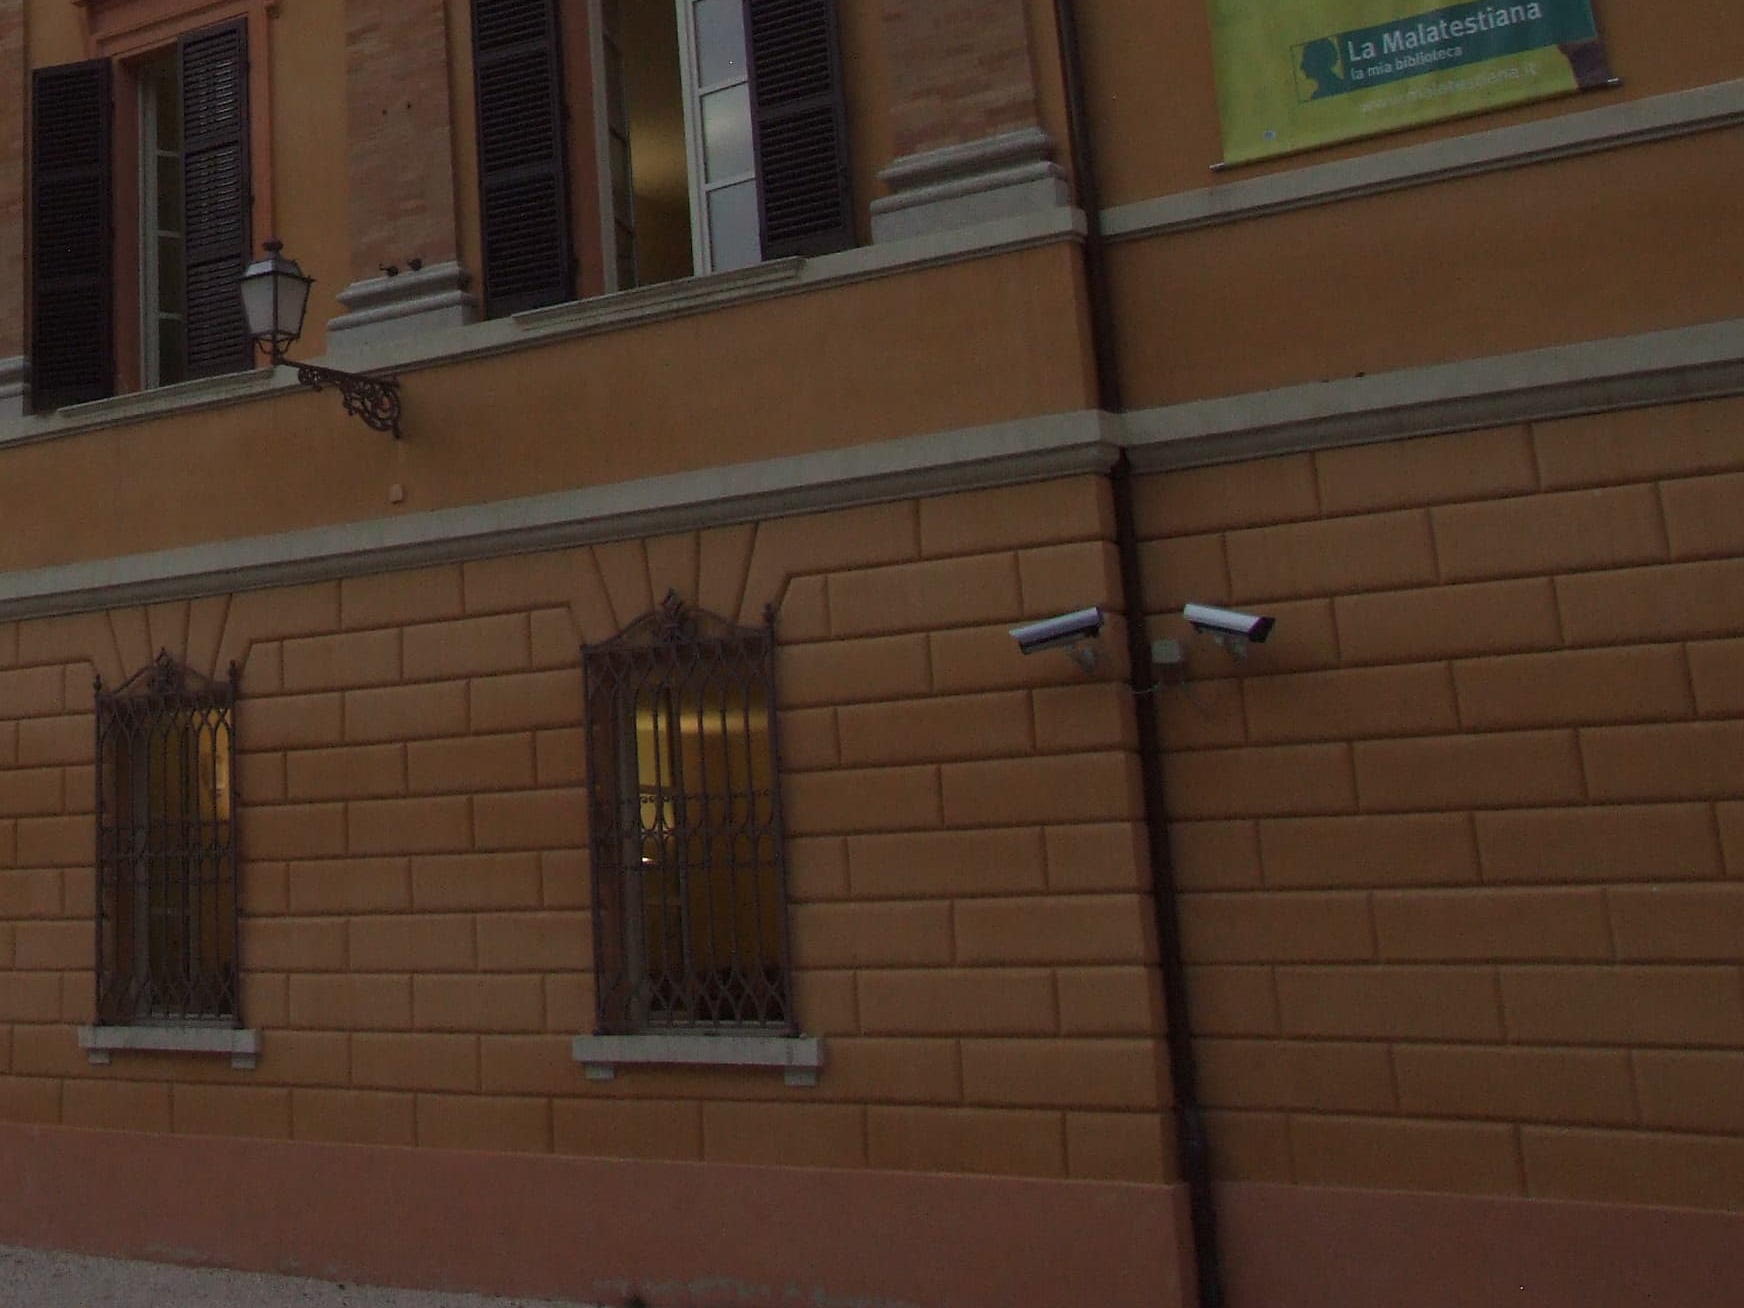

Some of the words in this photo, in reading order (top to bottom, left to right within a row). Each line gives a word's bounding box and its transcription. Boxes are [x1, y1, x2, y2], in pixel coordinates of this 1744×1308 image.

[1348, 39, 1375, 62] La
[1382, 1, 1542, 53] Malatestiana
[1351, 66, 1364, 81] la
[1368, 62, 1393, 78] mia
[1396, 45, 1463, 71] biblioteca
